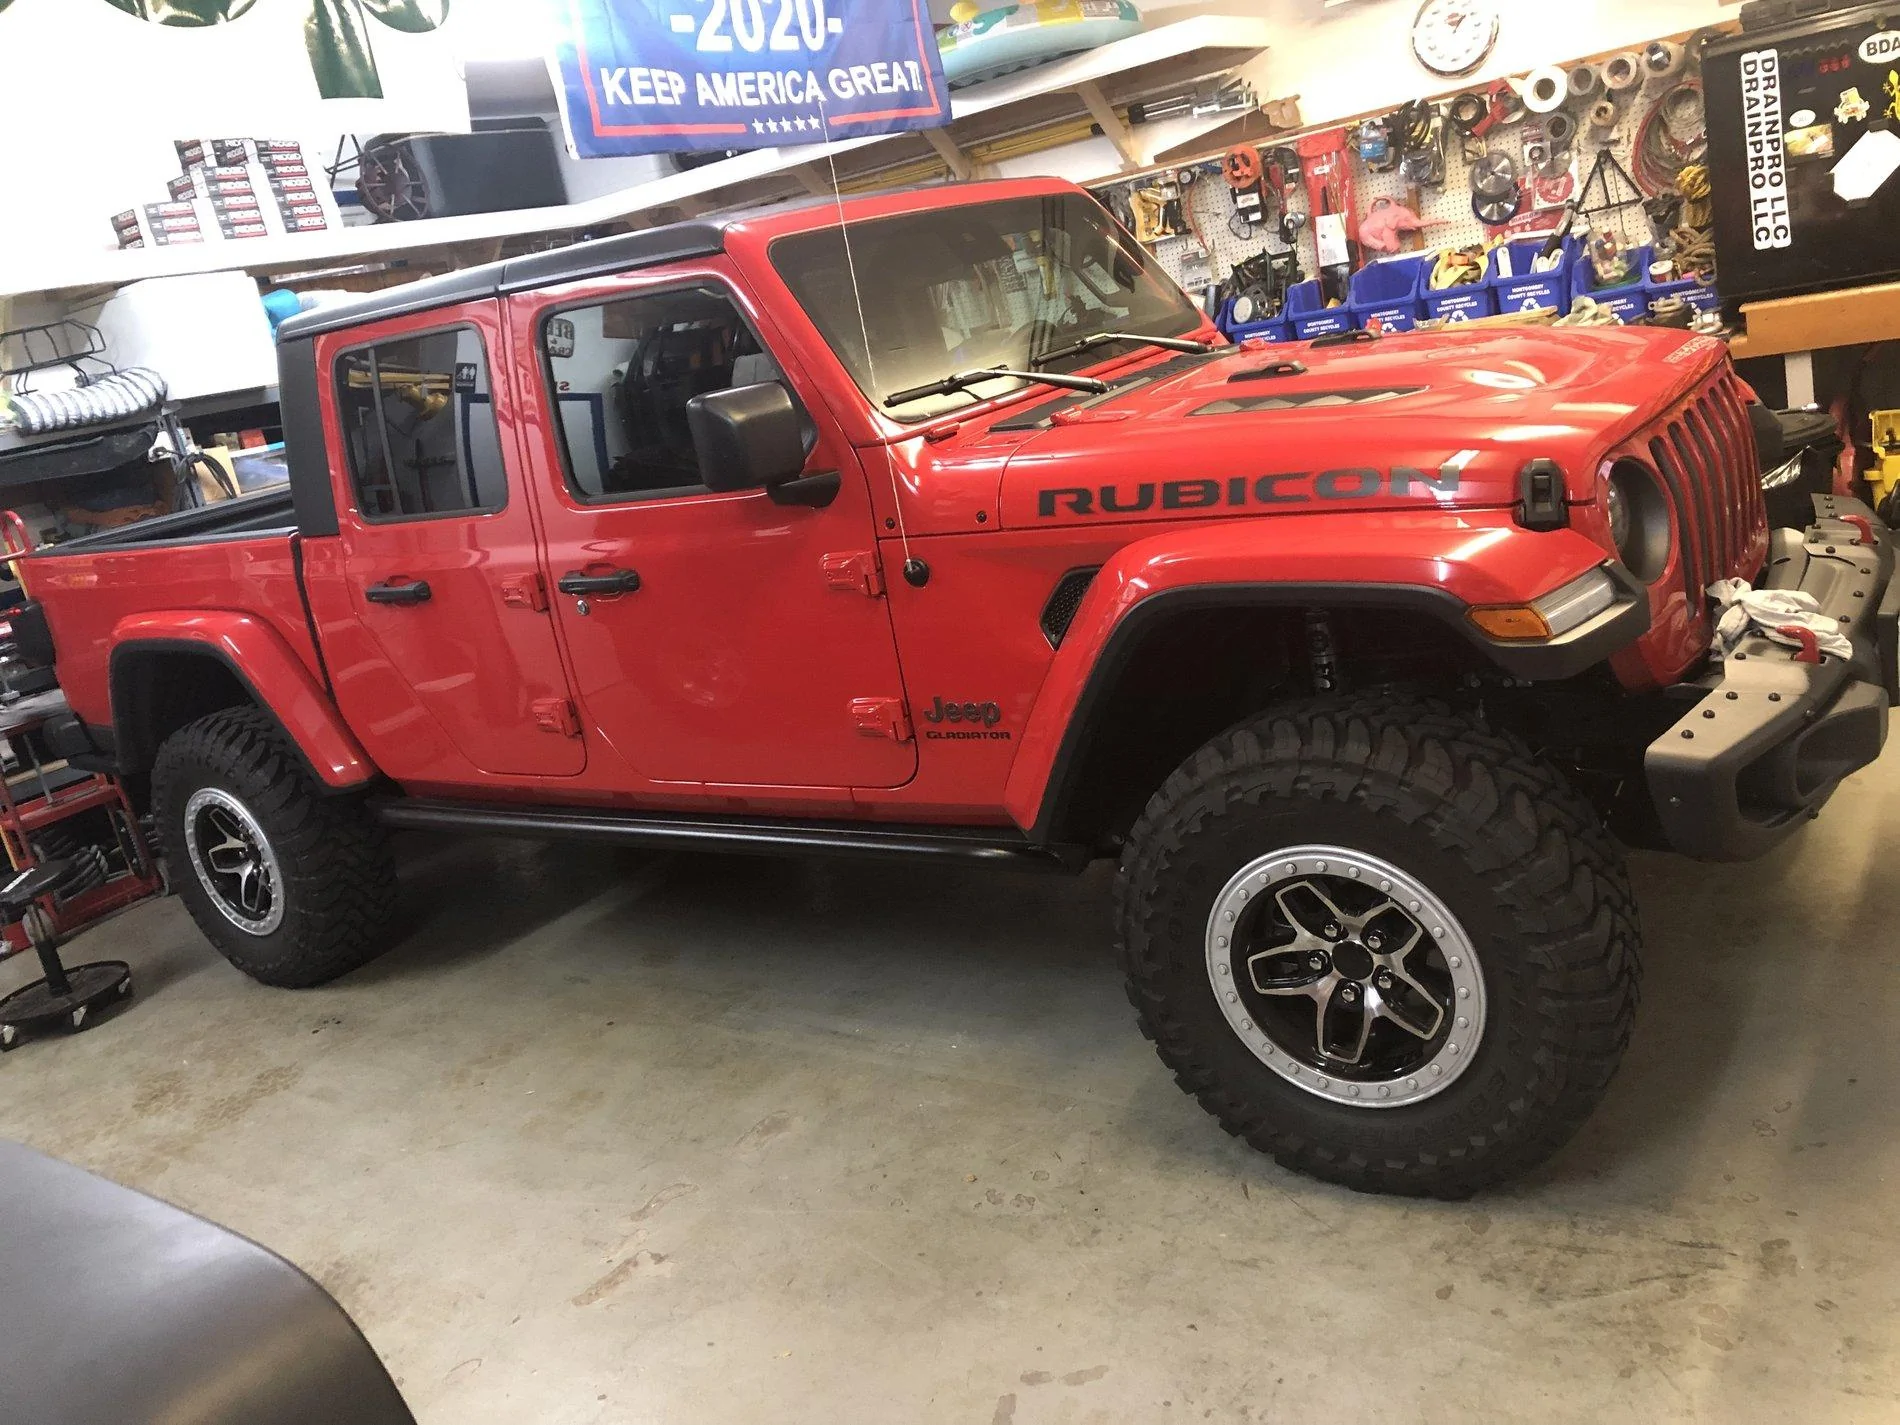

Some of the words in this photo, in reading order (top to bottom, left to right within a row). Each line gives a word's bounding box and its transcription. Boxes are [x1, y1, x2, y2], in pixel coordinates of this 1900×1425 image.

[601, 67, 686, 106] KEEP
[699, 70, 826, 107] AMERICA
[828, 61, 923, 100] GREAT!
[1743, 58, 1766, 189] DRAINPRO
[1761, 56, 1784, 188] DRAINPRO
[1753, 197, 1771, 242] LLC
[1771, 195, 1789, 240] LLC
[1038, 464, 1460, 517] RUBICON
[924, 696, 1002, 728] Jeep
[926, 730, 1012, 740] GLADIATOR
